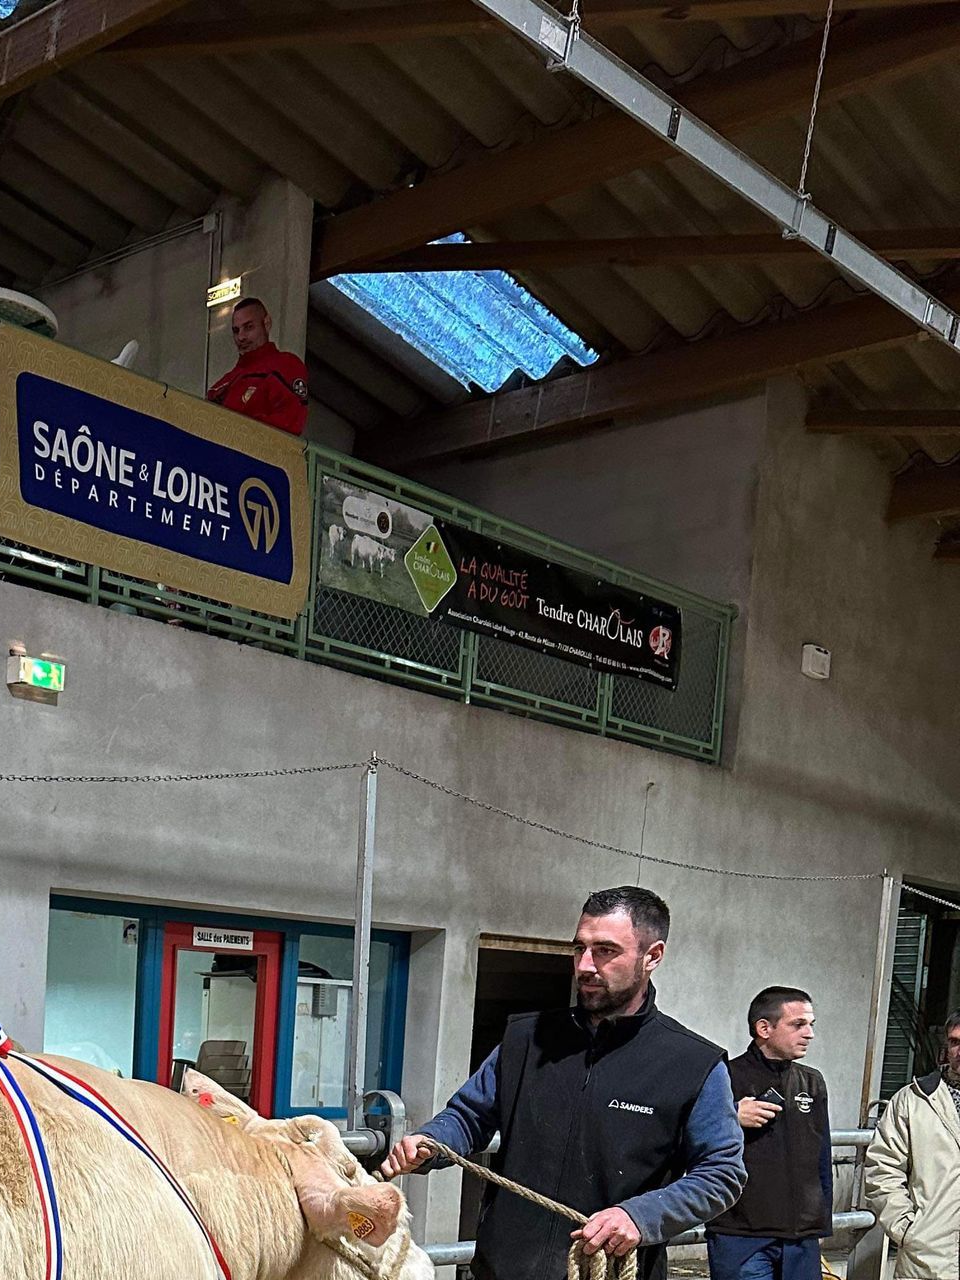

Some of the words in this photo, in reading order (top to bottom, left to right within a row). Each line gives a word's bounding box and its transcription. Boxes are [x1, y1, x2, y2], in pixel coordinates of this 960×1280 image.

[33, 420, 137, 487] SAÔNE
[139, 463, 149, 483] &
[152, 461, 231, 518] LOIRE
[34, 463, 231, 541] DÉPARTEMENT
[460, 556, 477, 576] LA
[481, 562, 528, 590] QUALITÉ
[467, 580, 477, 599] A
[480, 582, 498, 603] DU
[536, 597, 574, 624] Tendre
[577, 608, 643, 648] CHAROLAIS
[197, 932, 212, 942] SALLE
[213, 933, 222, 943] des
[223, 934, 249, 945] PAIEMENTS
[620, 1102, 654, 1115] SANDERS
